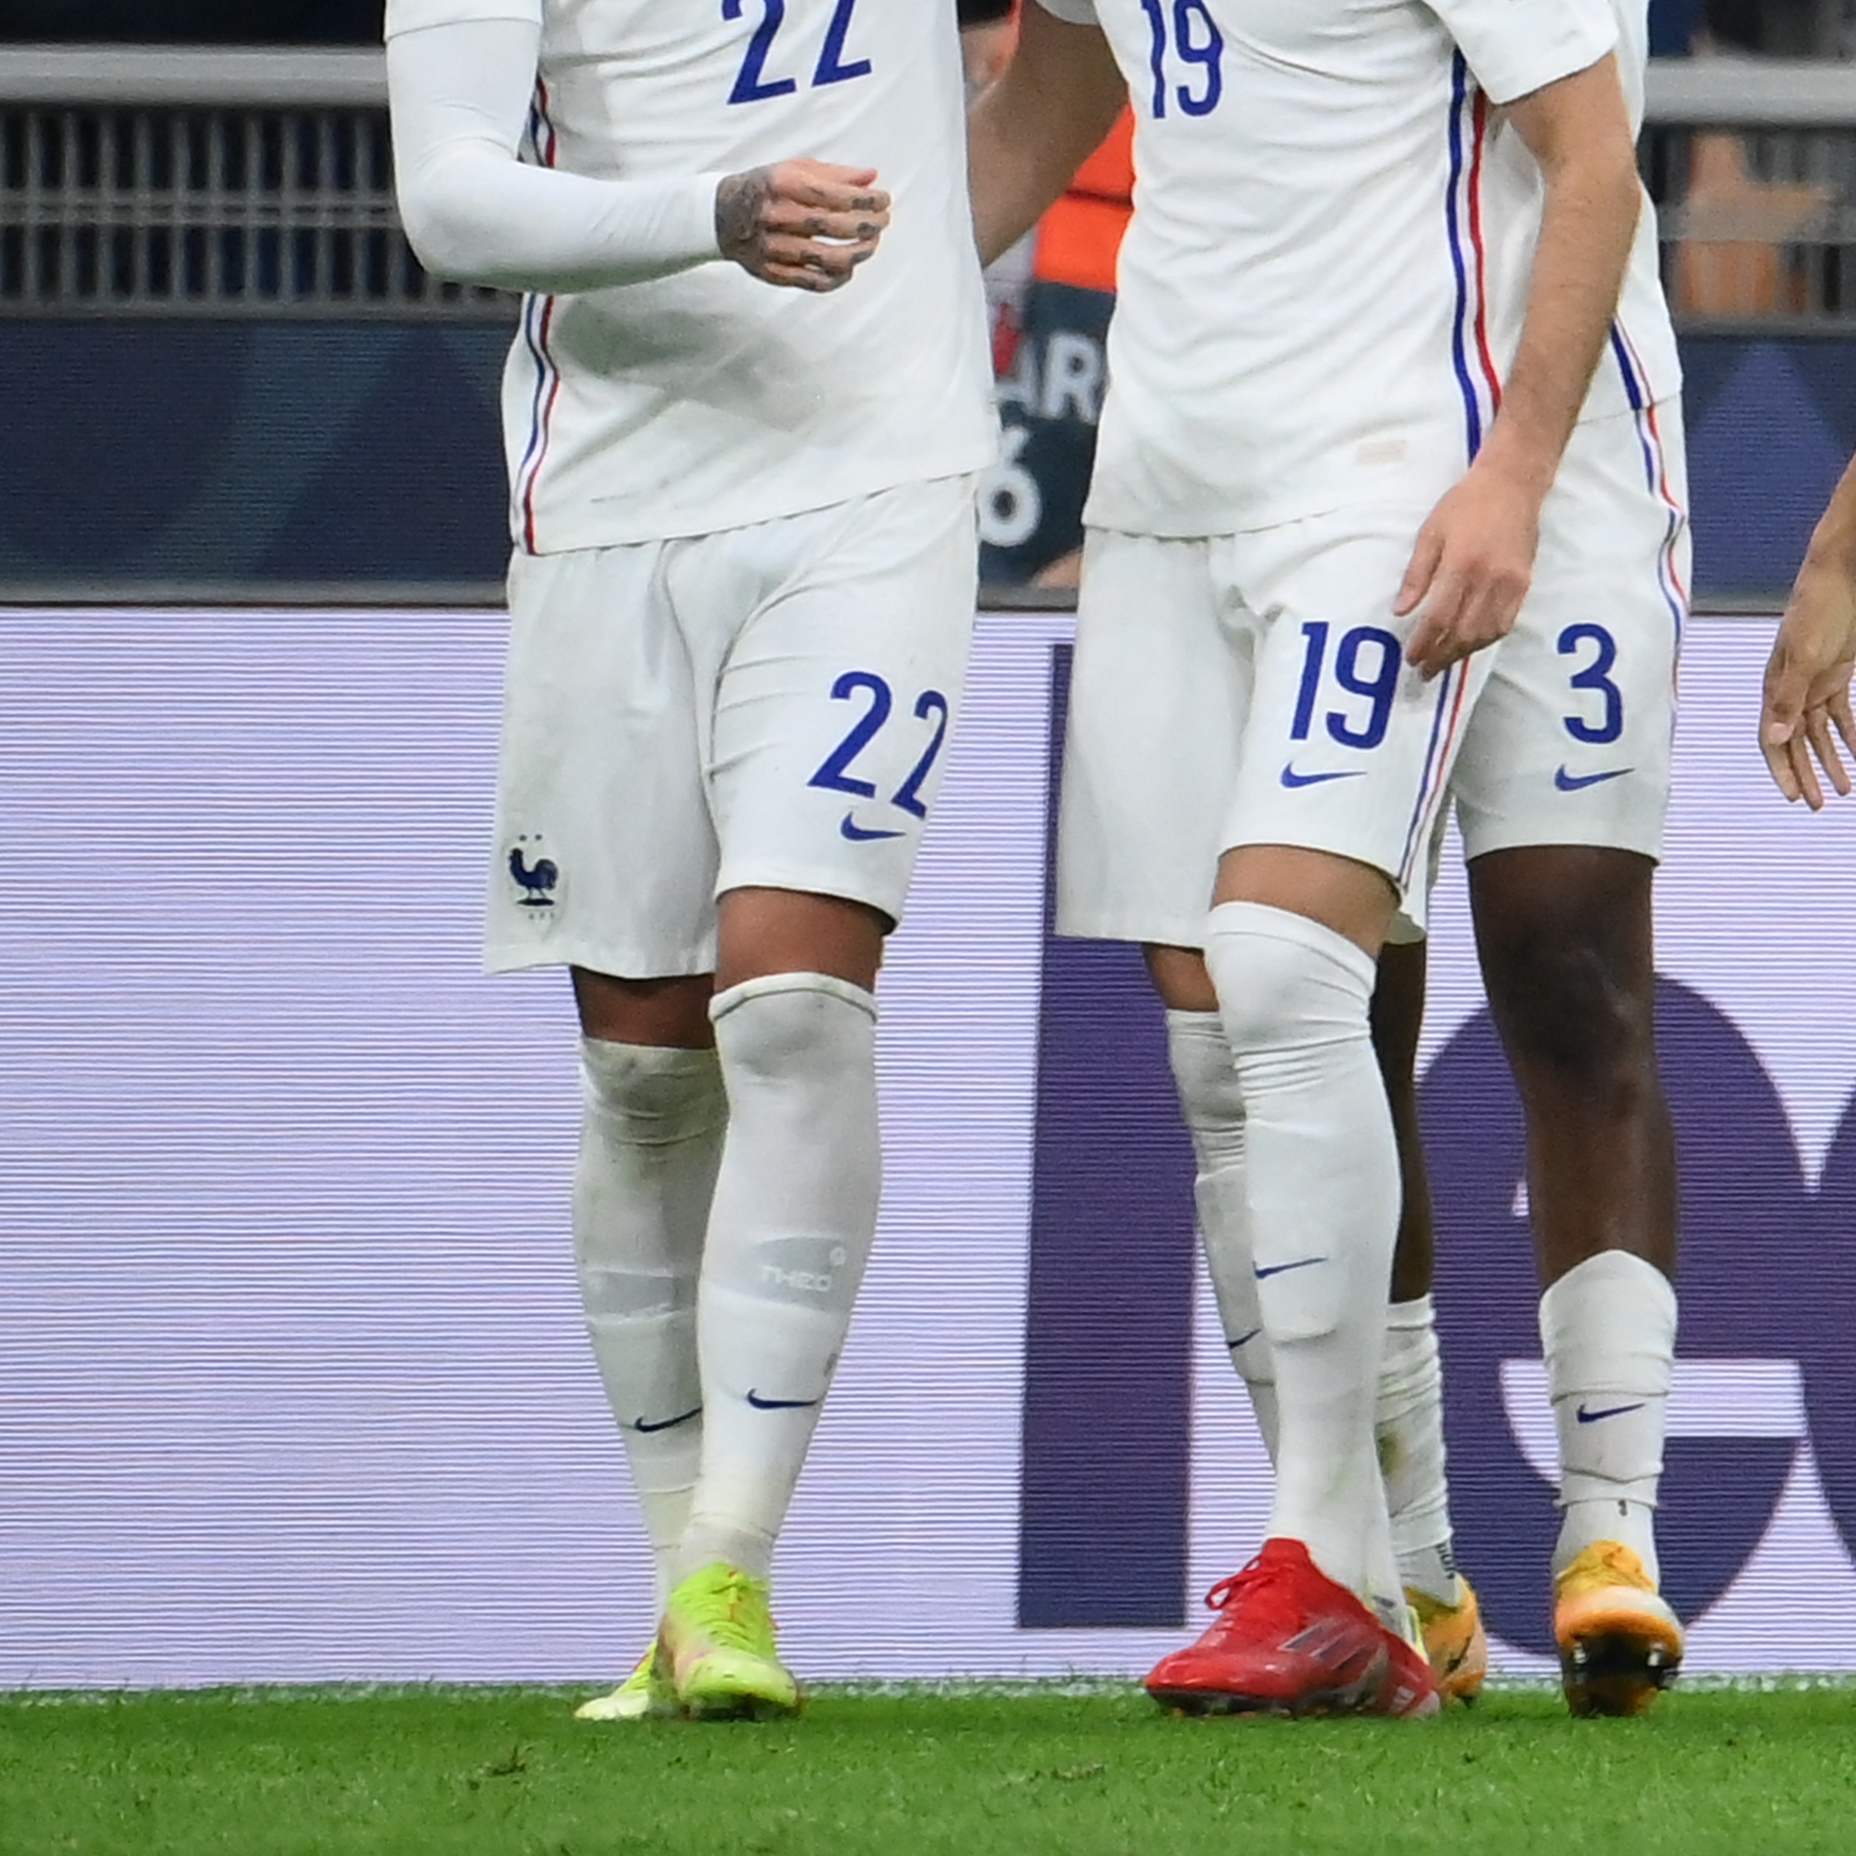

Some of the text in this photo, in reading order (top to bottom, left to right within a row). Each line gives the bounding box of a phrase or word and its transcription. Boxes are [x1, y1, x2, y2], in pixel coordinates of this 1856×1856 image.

[808, 671, 948, 819] 22
[1290, 621, 1402, 749] 19
[1557, 623, 1623, 744] 3
